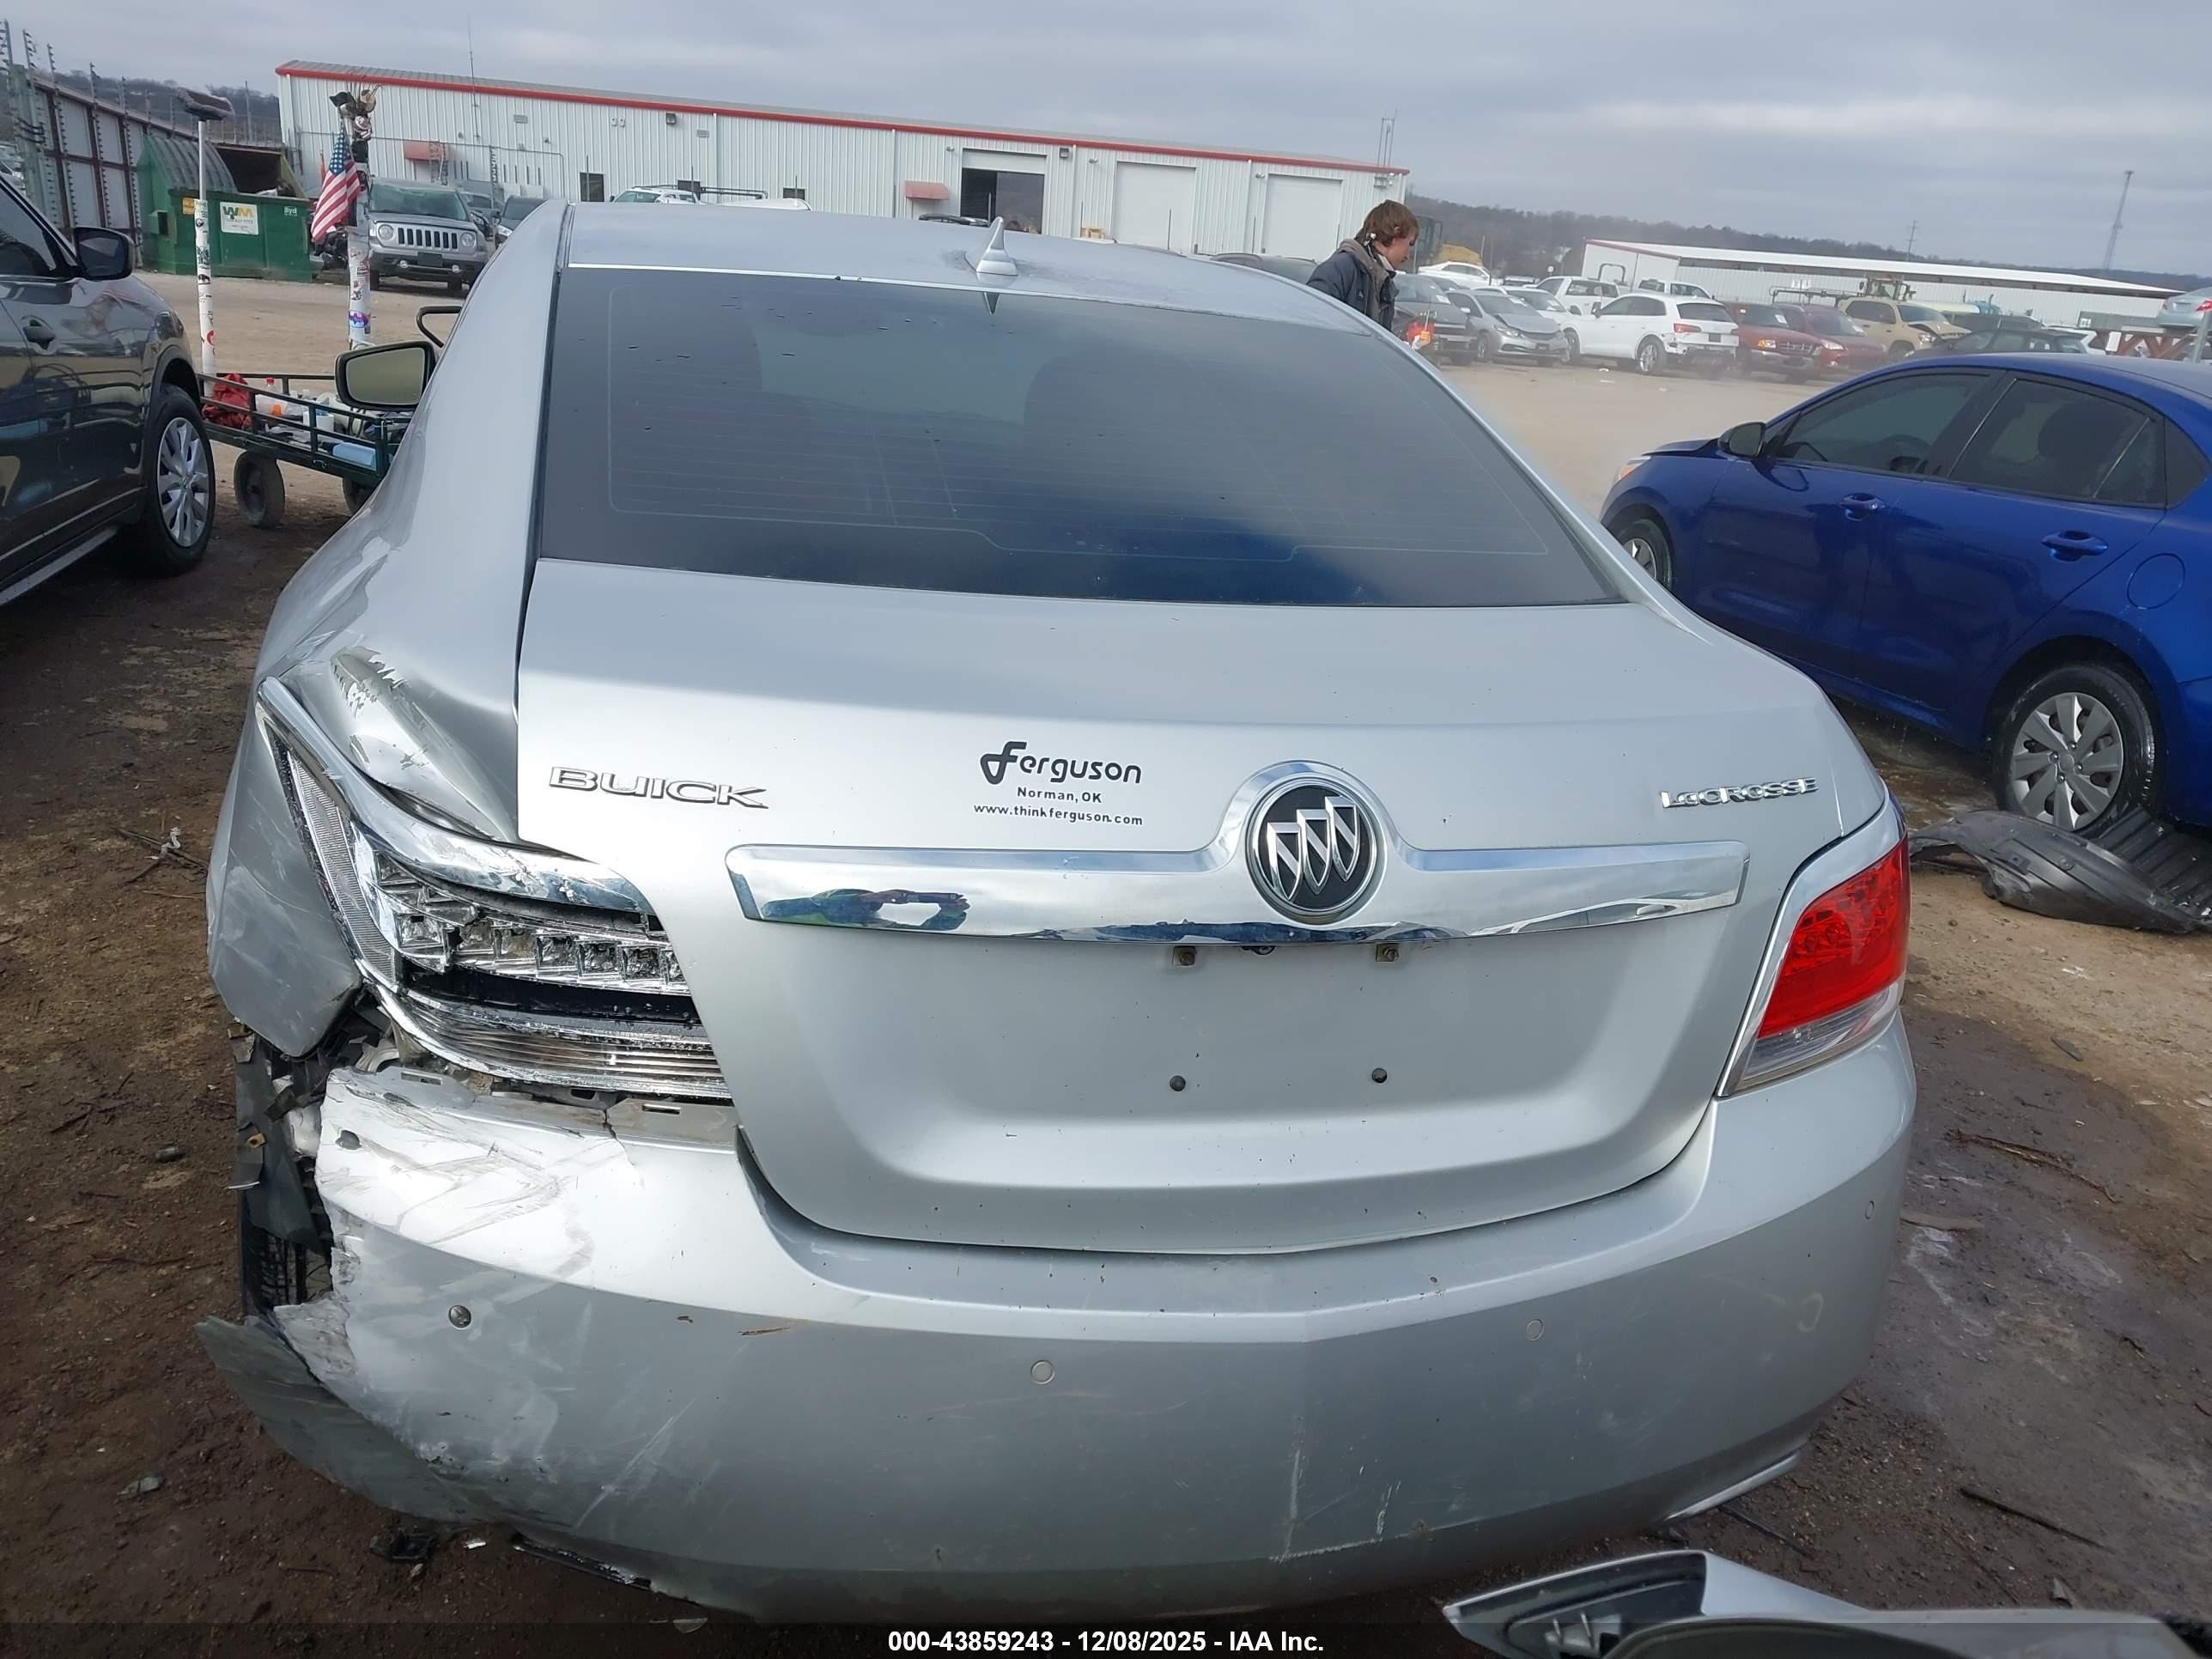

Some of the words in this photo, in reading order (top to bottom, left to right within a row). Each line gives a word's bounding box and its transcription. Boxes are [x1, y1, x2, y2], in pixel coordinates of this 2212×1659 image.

[549, 767, 769, 809] BUICK
[1018, 787, 1078, 804] Norman,
[1082, 792, 1102, 803] OK
[975, 805, 1142, 825] www.thinkferguson.com
